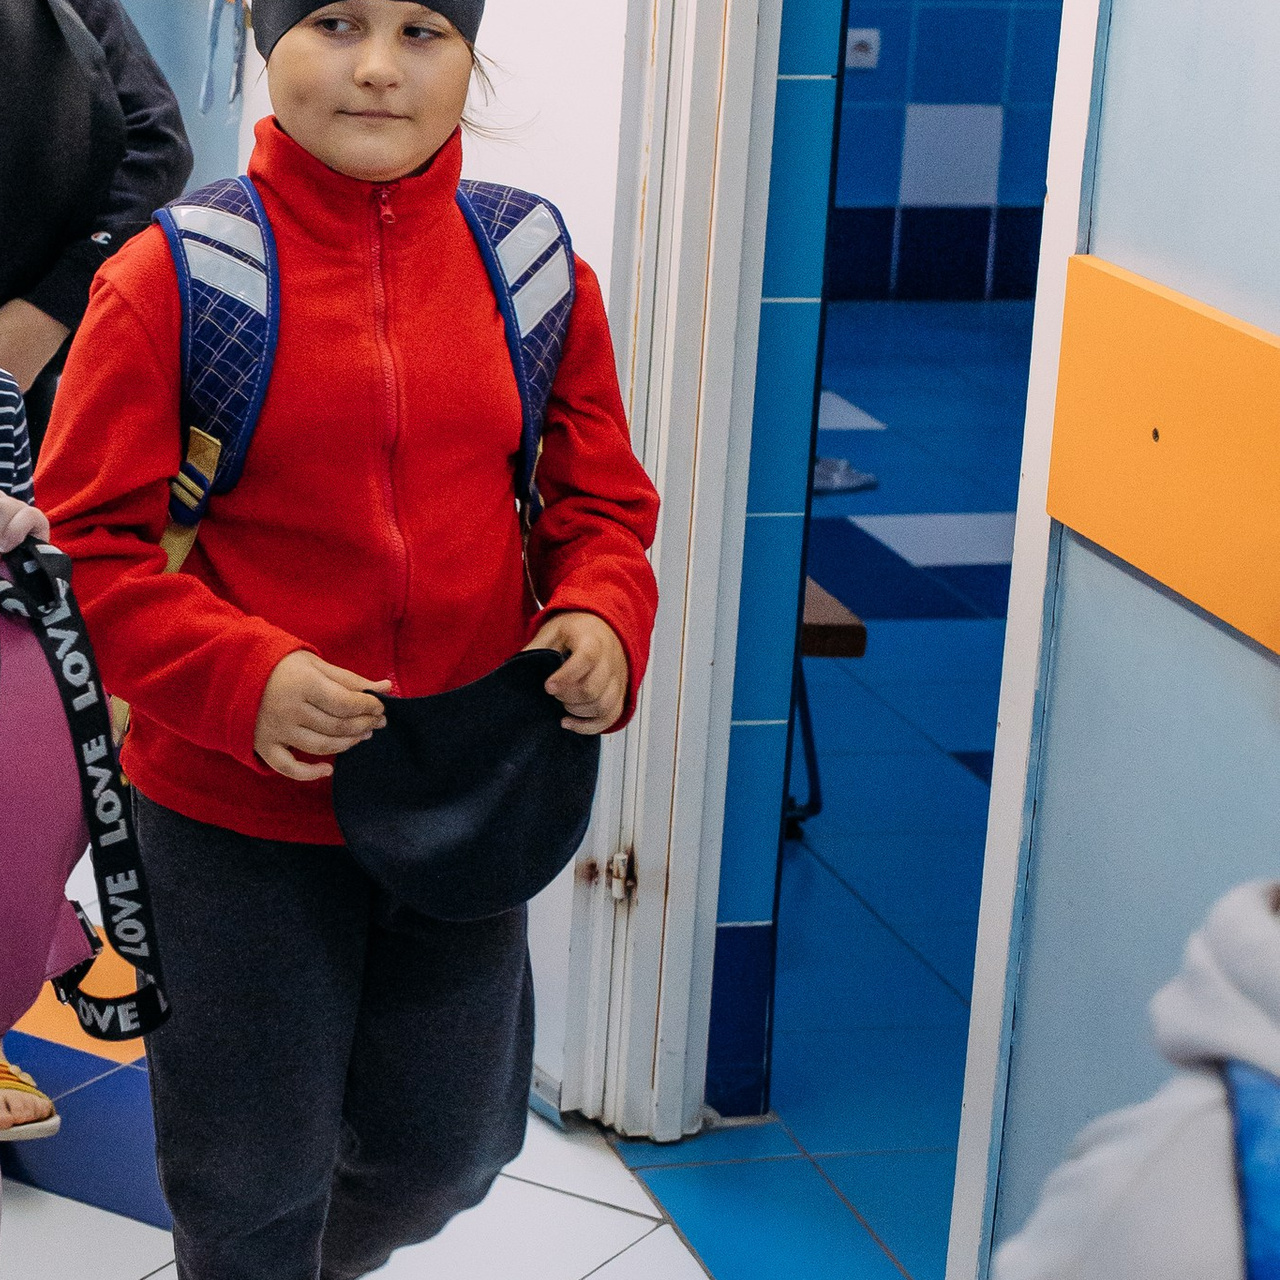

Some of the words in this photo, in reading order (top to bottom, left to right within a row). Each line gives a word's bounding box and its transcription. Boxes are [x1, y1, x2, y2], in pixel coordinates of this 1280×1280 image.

[82, 734, 128, 847] LOVE
[105, 869, 150, 957] LOVE
[78, 996, 141, 1033] OVE
